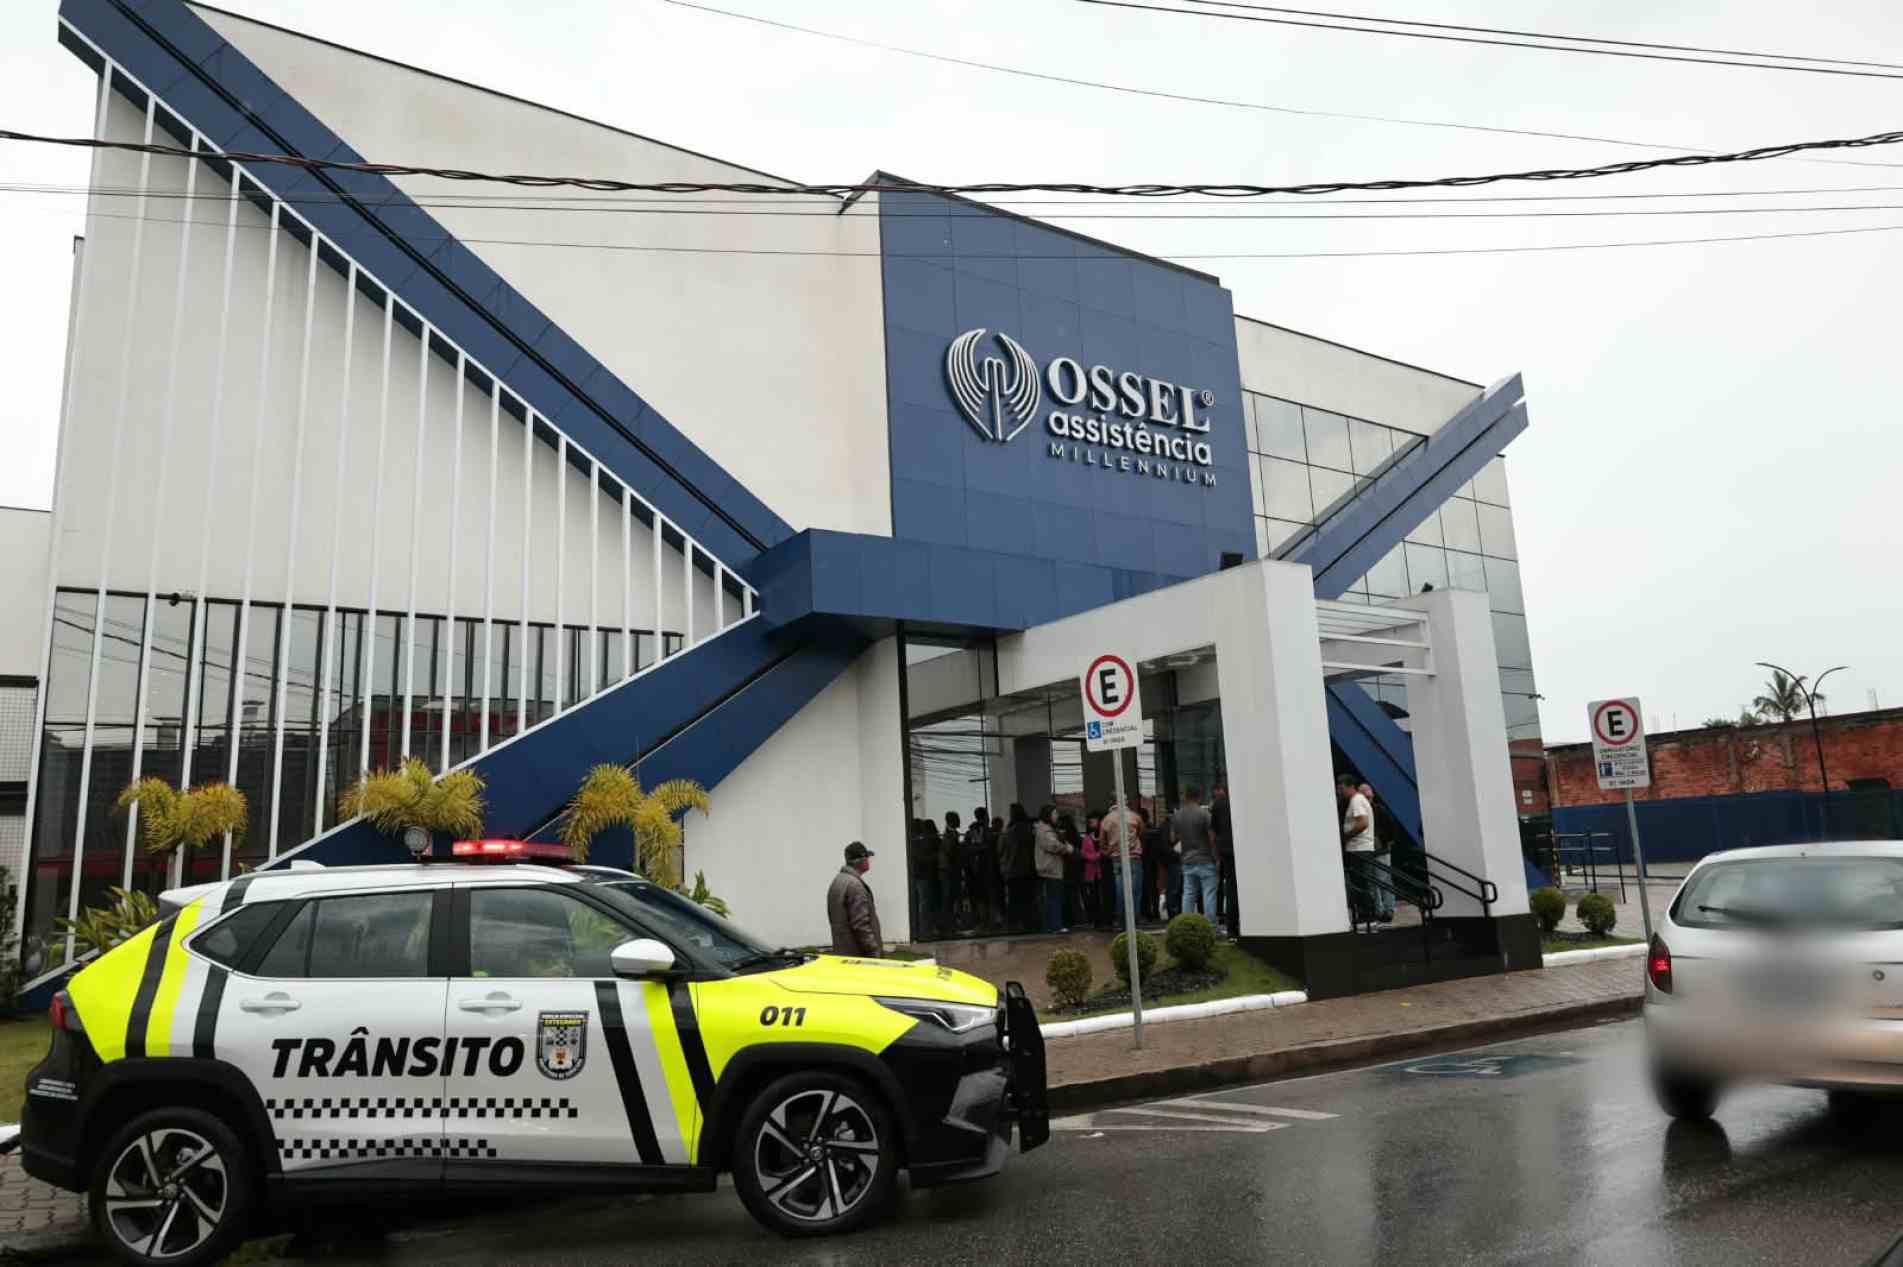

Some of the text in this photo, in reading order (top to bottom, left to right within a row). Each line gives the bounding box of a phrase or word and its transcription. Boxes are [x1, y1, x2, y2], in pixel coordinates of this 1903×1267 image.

[1049, 411, 1213, 465] assistência
[1050, 443, 1217, 487] MILLENNIUM
[1099, 668, 1119, 705] E
[1607, 710, 1626, 737] E
[759, 1005, 807, 1027] 011
[271, 1026, 526, 1078] TRÂNSITO
